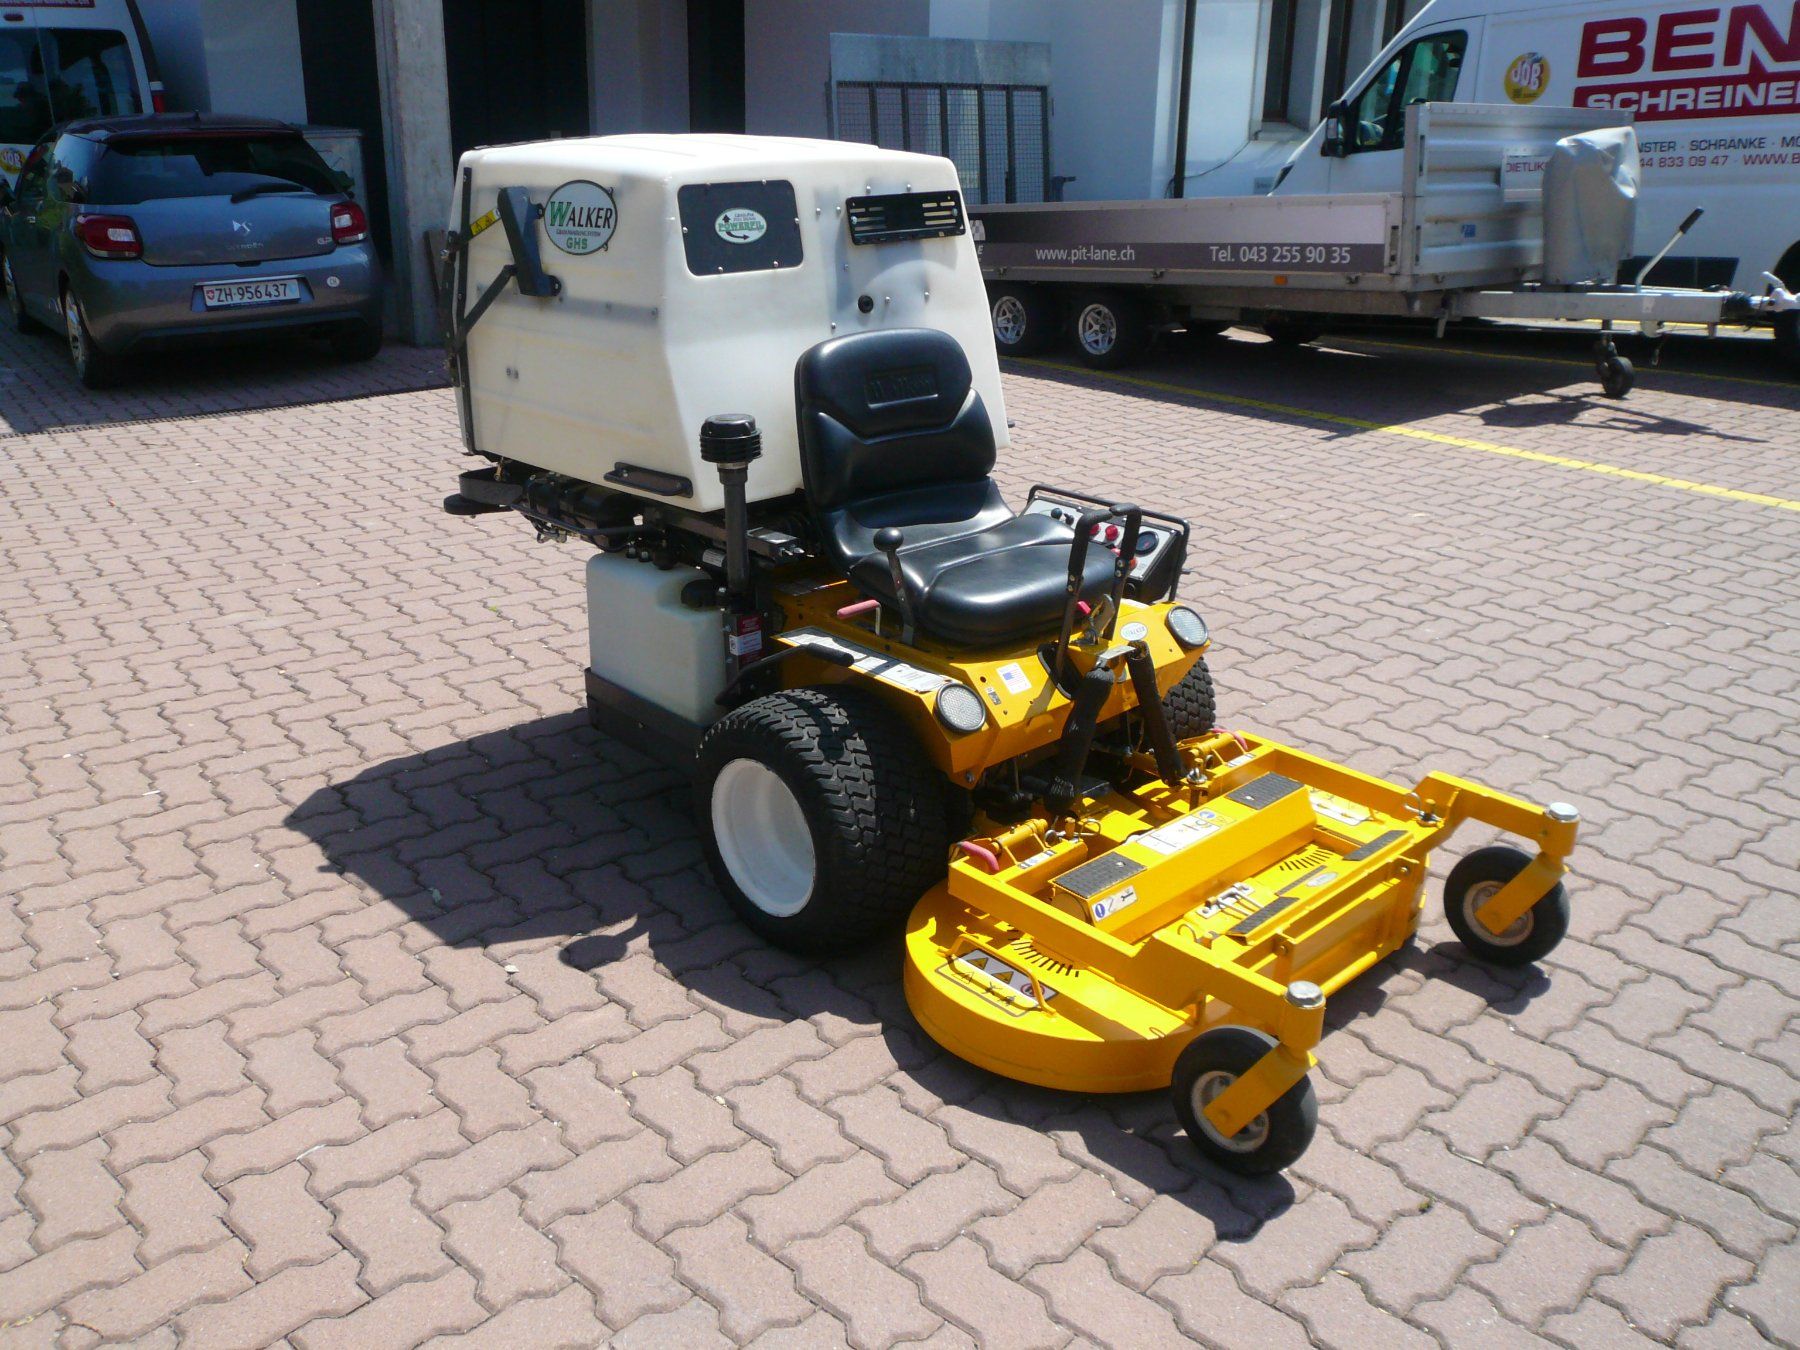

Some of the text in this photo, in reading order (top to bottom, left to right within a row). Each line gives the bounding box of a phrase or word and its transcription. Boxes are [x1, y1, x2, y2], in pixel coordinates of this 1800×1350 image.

[1587, 80, 1800, 113] SCHREINE
[1659, 156, 1684, 167] 833
[1689, 155, 1706, 166] 09
[1711, 155, 1729, 166] 47
[550, 201, 613, 229] WALKER
[1036, 245, 1135, 263] www.pit-lane.ch
[1209, 245, 1351, 264] Tel. 043 255 90 35
